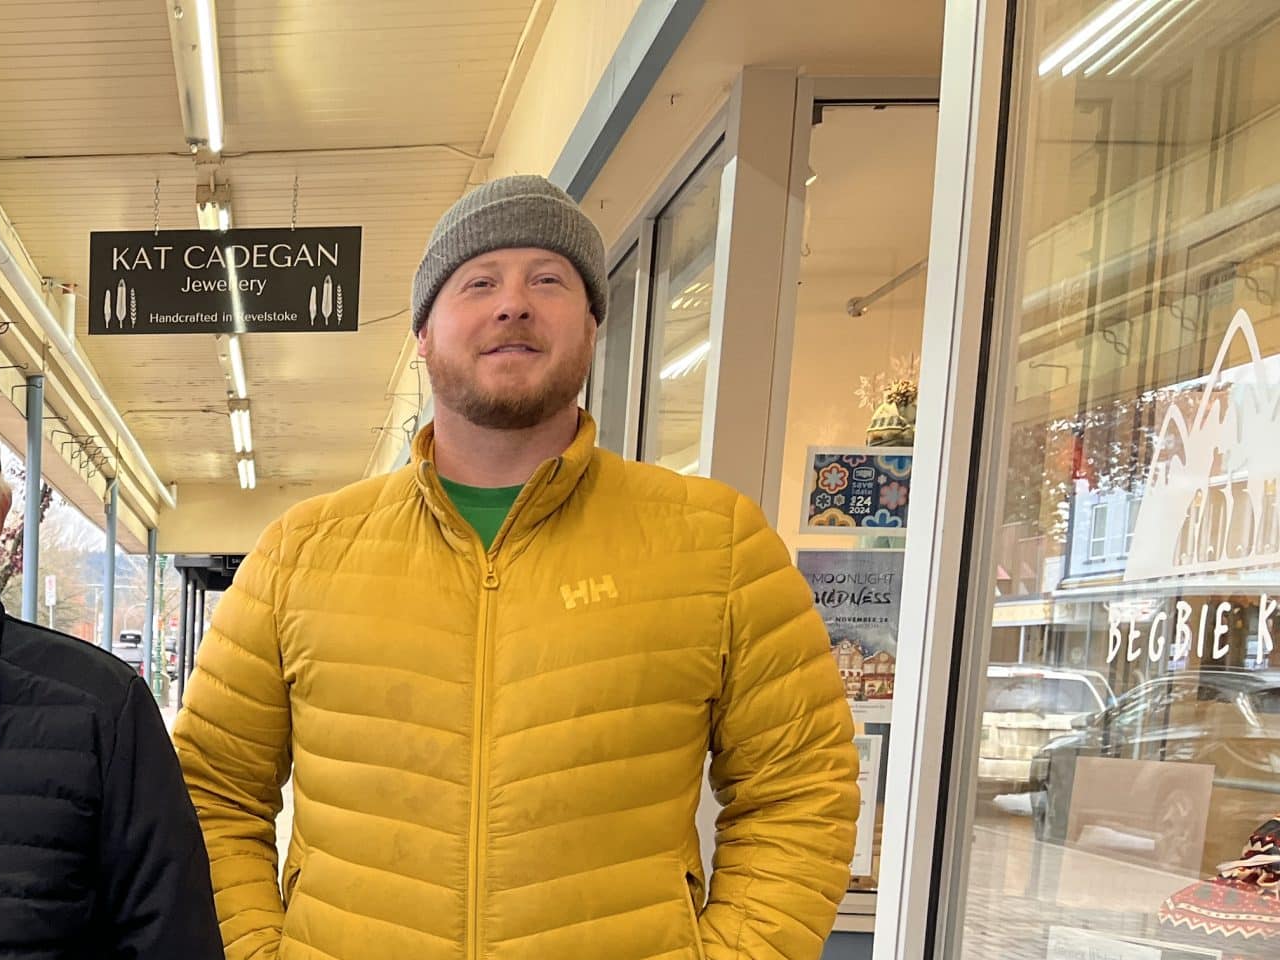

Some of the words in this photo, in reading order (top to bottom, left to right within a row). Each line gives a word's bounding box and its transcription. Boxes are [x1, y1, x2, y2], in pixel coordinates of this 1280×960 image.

[112, 246, 173, 271] KAT
[183, 243, 339, 270] CADEGAN
[181, 276, 267, 295] Jewelery
[149, 311, 218, 324] Handcrafted
[222, 312, 233, 323] in
[848, 506, 871, 514] 2024
[811, 572, 896, 585] MOONLIGHT
[1104, 599, 1232, 664] BEGBIE
